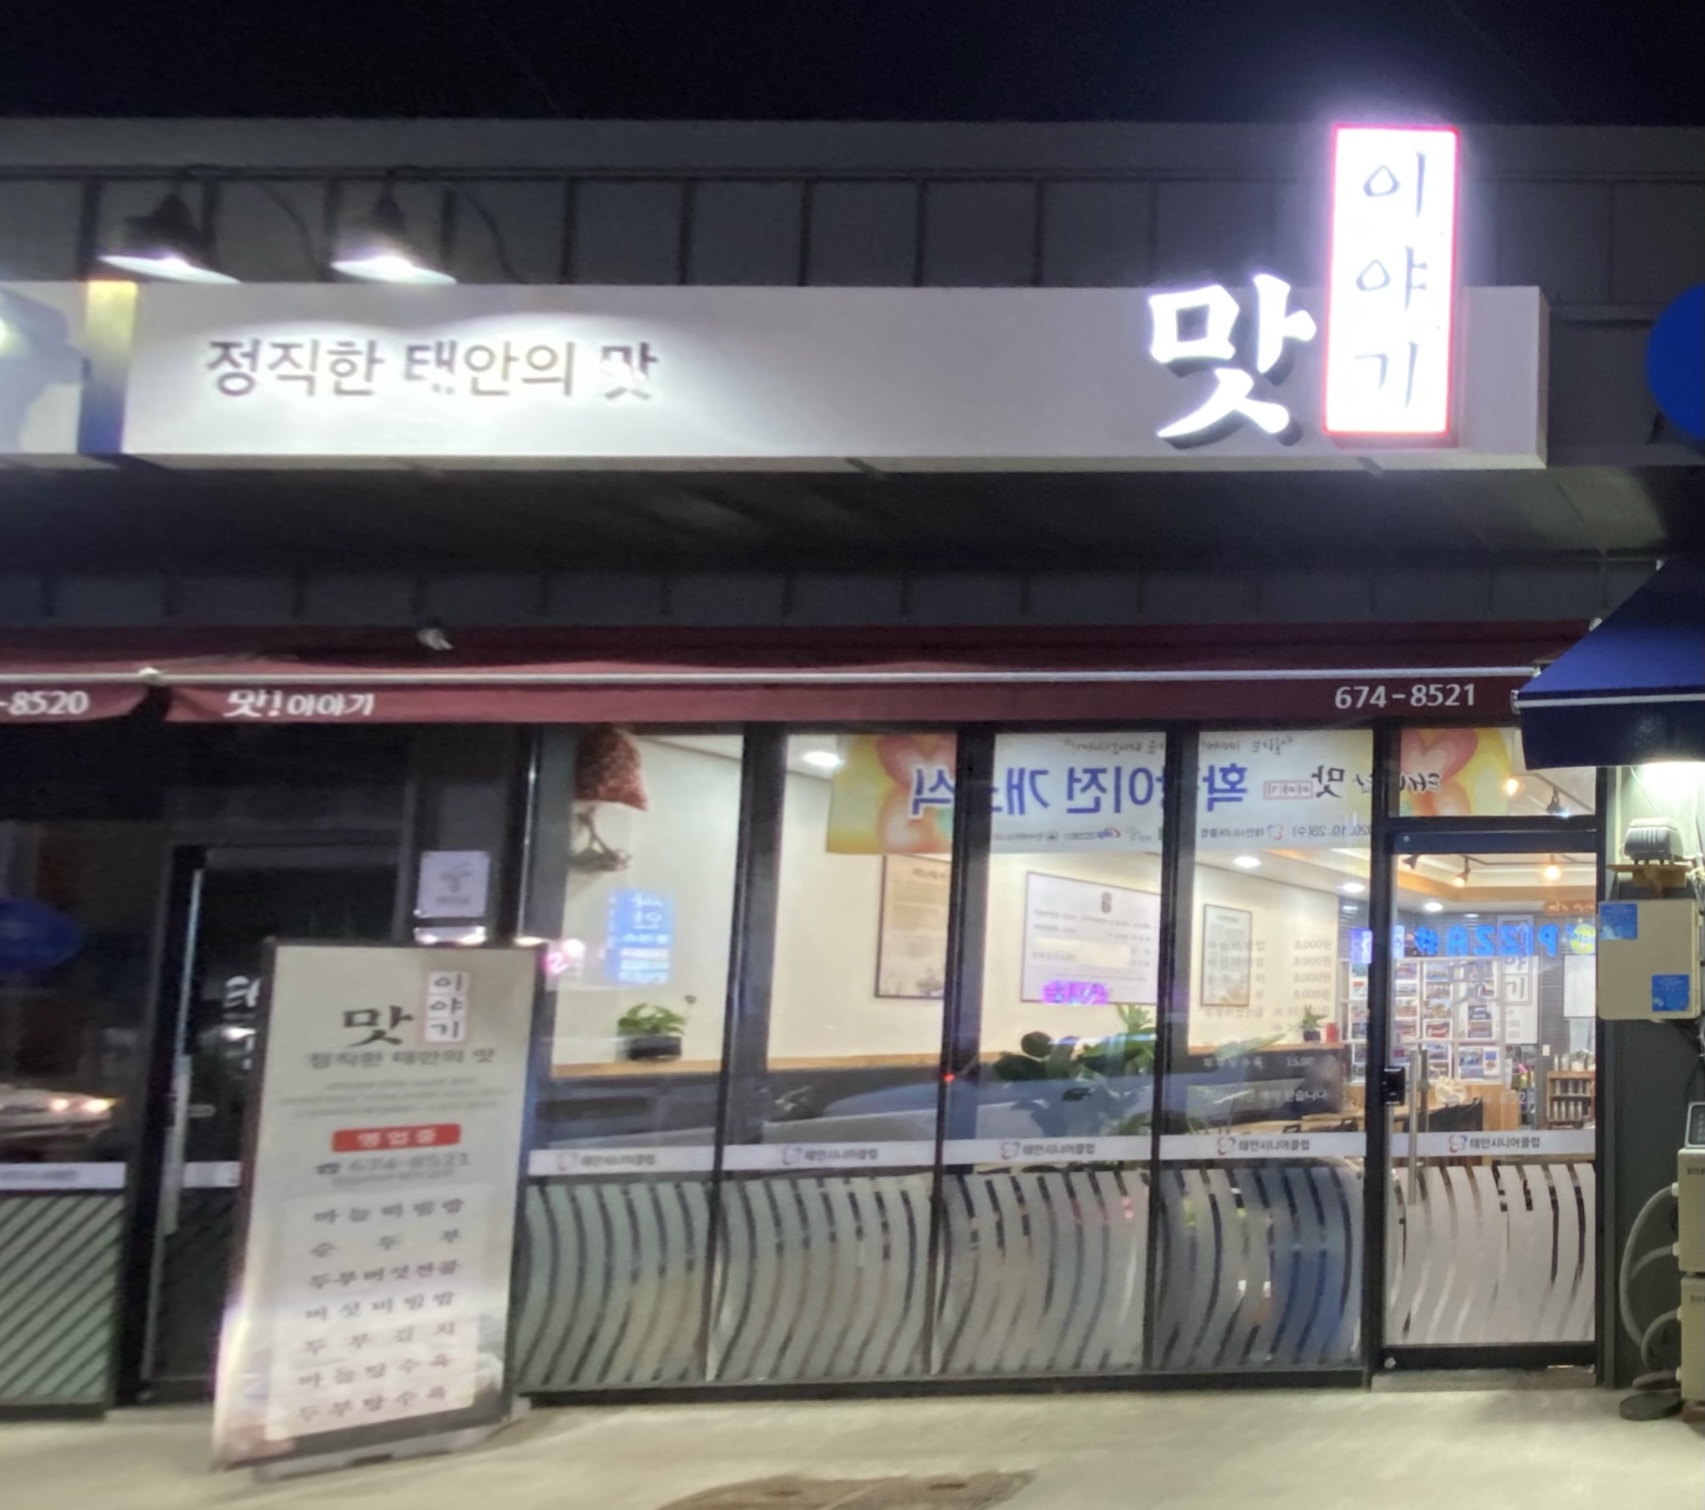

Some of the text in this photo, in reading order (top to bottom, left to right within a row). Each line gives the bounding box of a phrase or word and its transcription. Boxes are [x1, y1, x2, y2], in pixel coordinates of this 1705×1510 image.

[1354, 152, 1428, 408] 이야기
[206, 338, 659, 399] 정직한 태안의 맛
[1148, 272, 1317, 438] 맛
[1334, 683, 1476, 710] 674-8521
[341, 1005, 415, 1048] 맛
[427, 974, 465, 1040] 이야기
[1238, 1138, 1311, 1152] 태안시니어클럽
[1469, 1136, 1541, 1150] 태안시니어클럽
